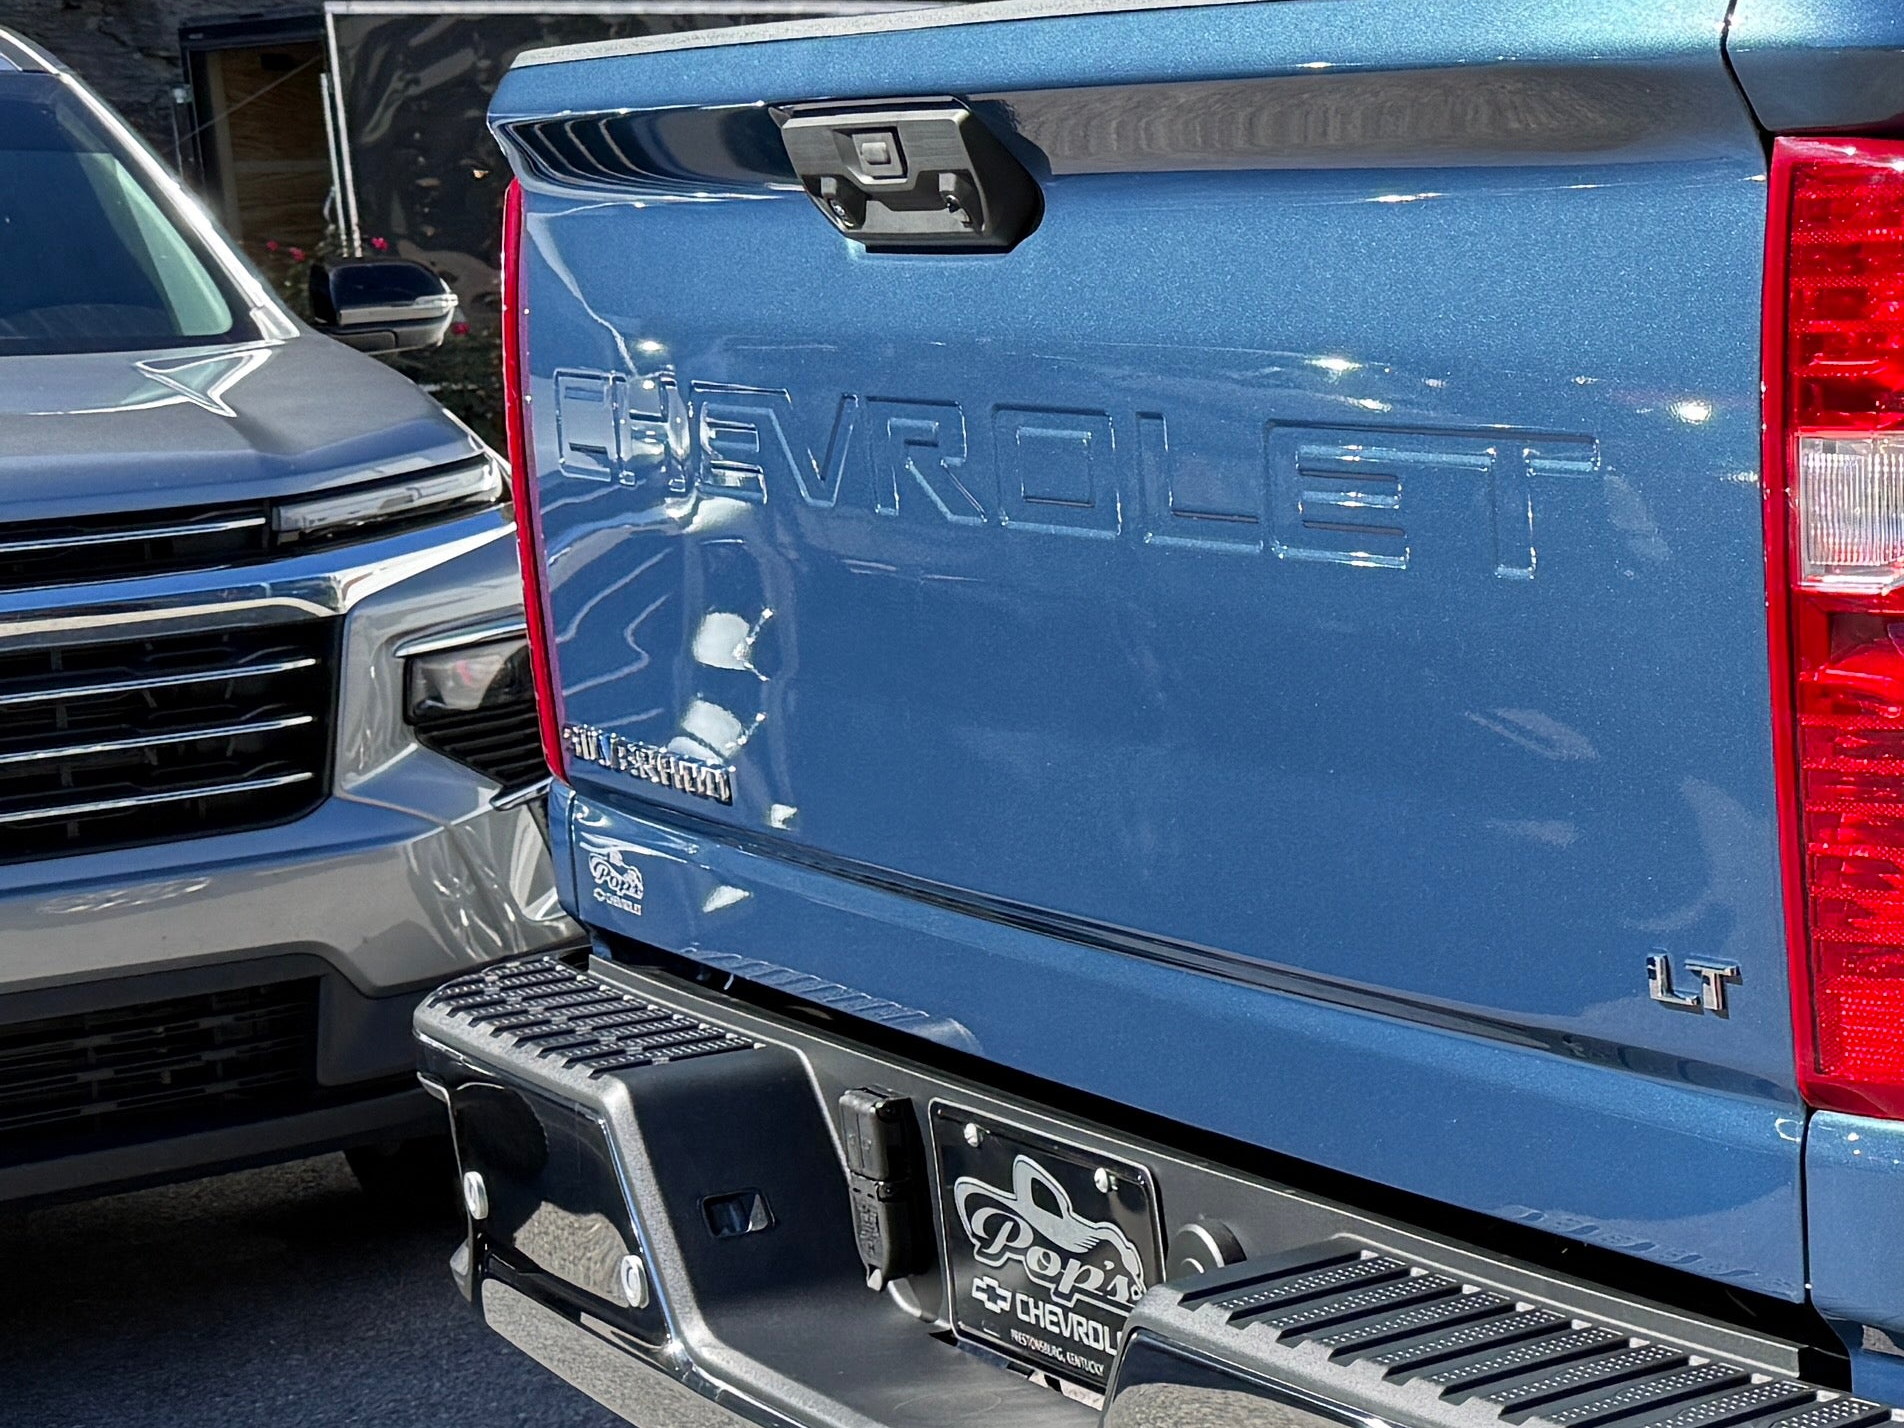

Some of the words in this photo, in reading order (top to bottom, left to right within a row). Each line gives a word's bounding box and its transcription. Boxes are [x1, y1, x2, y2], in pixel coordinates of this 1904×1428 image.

[553, 367, 1602, 582] CHEVROLET
[1645, 952, 1743, 1012] LT
[969, 1205, 1137, 1307] Pop's
[1014, 1291, 1124, 1358] CHEVROL
